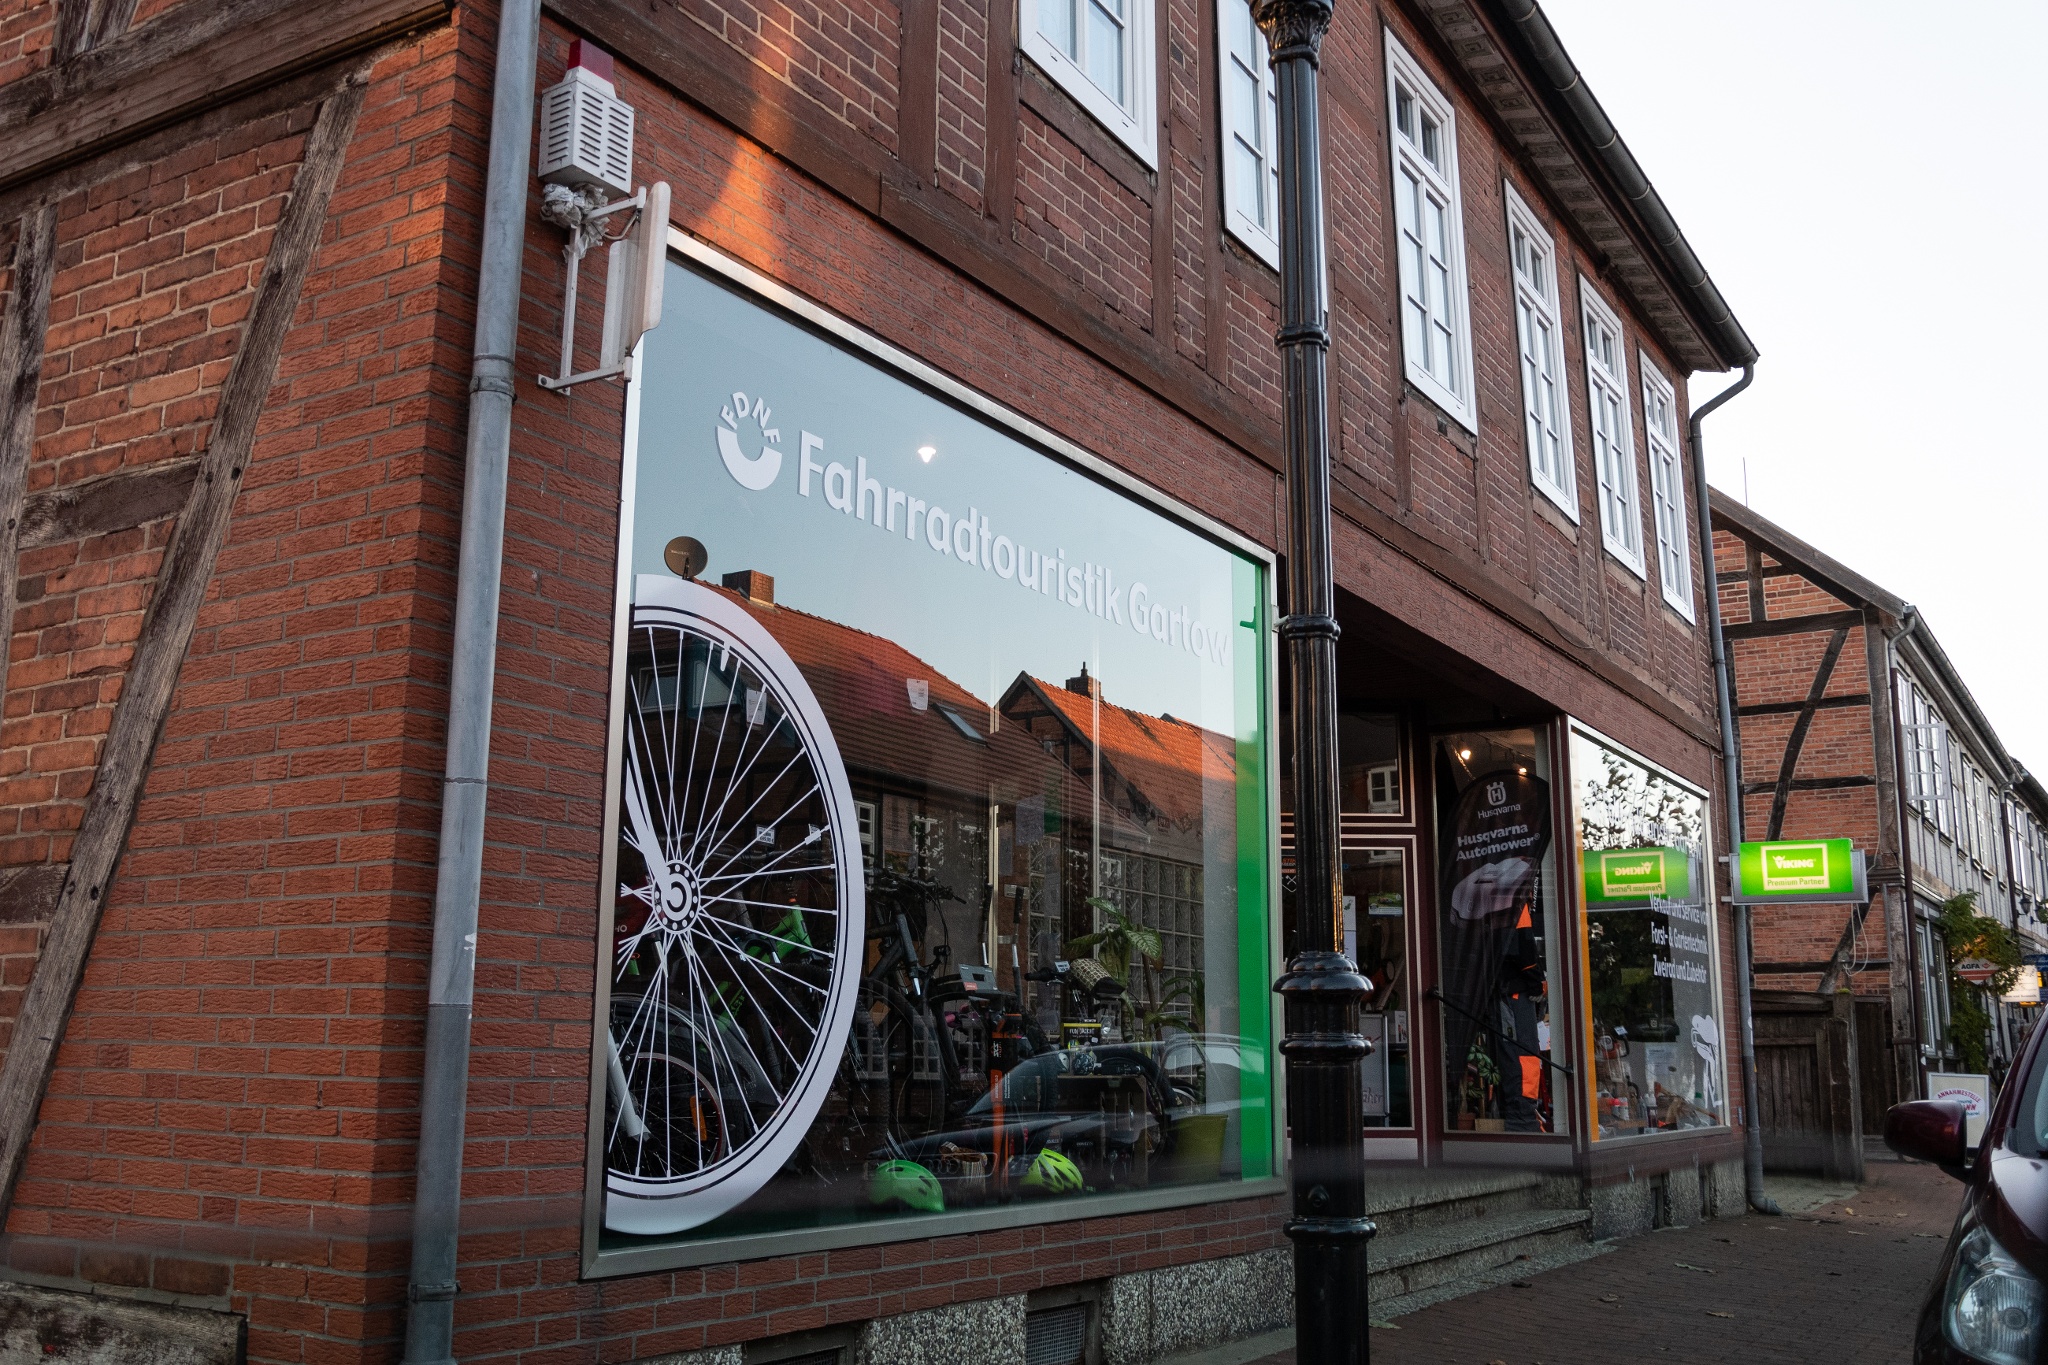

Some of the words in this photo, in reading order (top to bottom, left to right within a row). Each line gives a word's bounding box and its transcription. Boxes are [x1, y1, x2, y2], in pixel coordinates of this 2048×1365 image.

[719, 391, 781, 444] FDNF
[798, 429, 1122, 626] Fahrradtouristik
[1127, 581, 1231, 666] Gartow
[1478, 803, 1522, 819] Husqvarna
[1457, 824, 1529, 847] Husqvarna
[1773, 857, 1815, 869] VIKING
[1767, 878, 1798, 887] Premium
[1799, 877, 1825, 886] Partner
[1681, 899, 1700, 924] Service
[1651, 921, 1668, 946] Forst-
[1673, 927, 1708, 955] Gartentechnik
[1653, 954, 1677, 979] Zweirad
[1676, 959, 1687, 981] und
[1686, 960, 1707, 984] Zubehör
[1937, 1089, 1982, 1103] ANNAHMESTELLE
